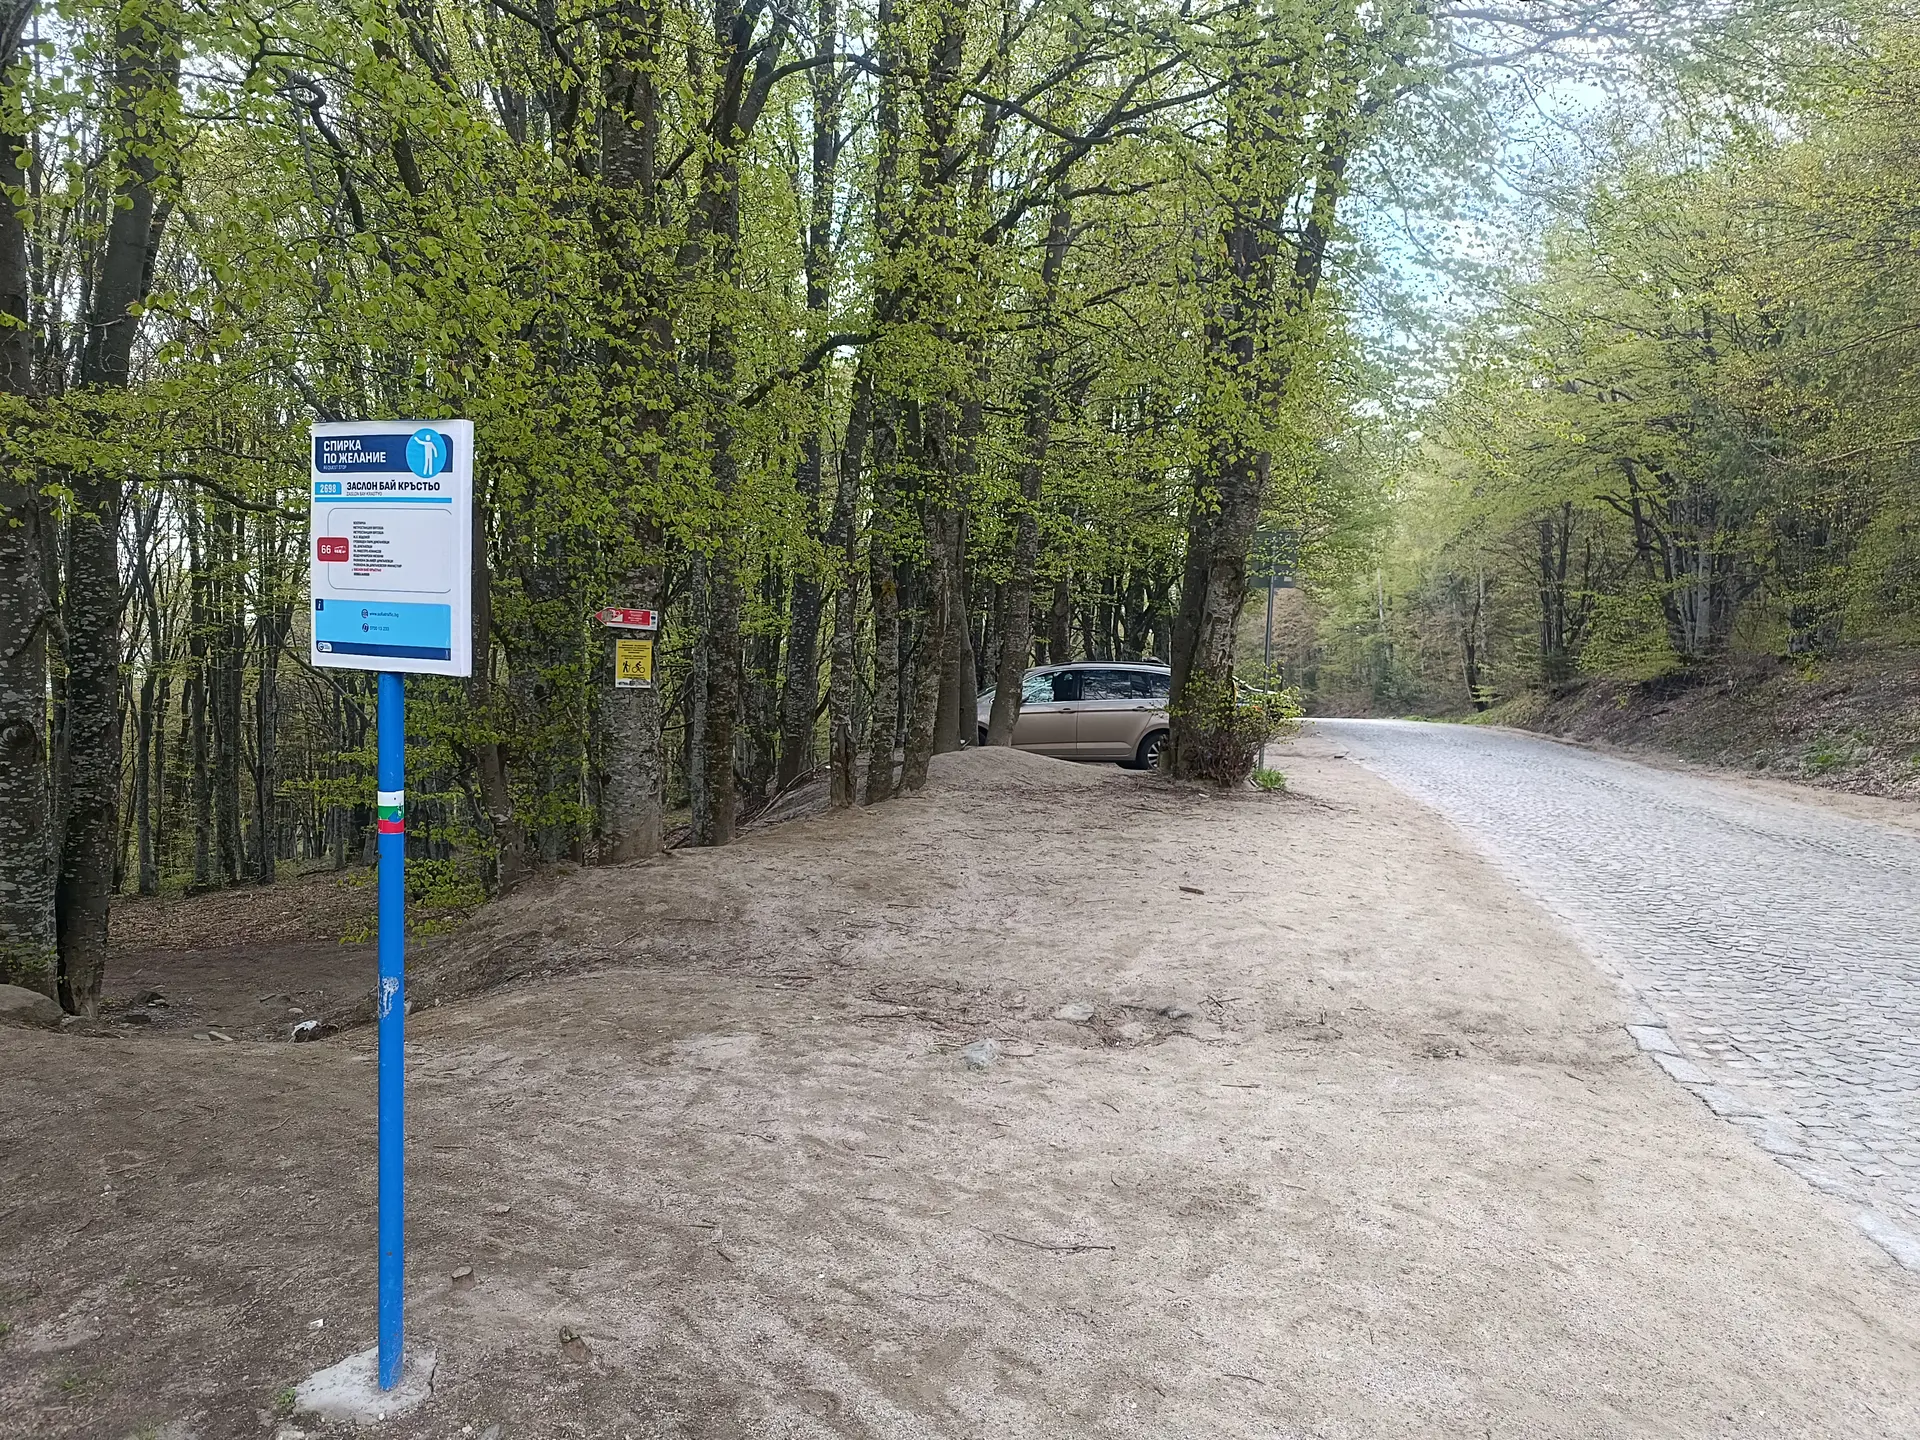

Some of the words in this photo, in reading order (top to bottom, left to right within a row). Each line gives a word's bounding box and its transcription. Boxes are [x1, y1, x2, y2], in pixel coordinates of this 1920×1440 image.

[323, 440, 362, 452] СПИРКА
[323, 453, 337, 464] ПО
[338, 451, 387, 464] ЖЕЛАНИЕ
[319, 484, 337, 494] 2698
[346, 481, 378, 491] ЗАСЛОН
[379, 479, 397, 491] БАЙ
[398, 481, 440, 491] КРЪСТЬО
[321, 544, 332, 554] 66
